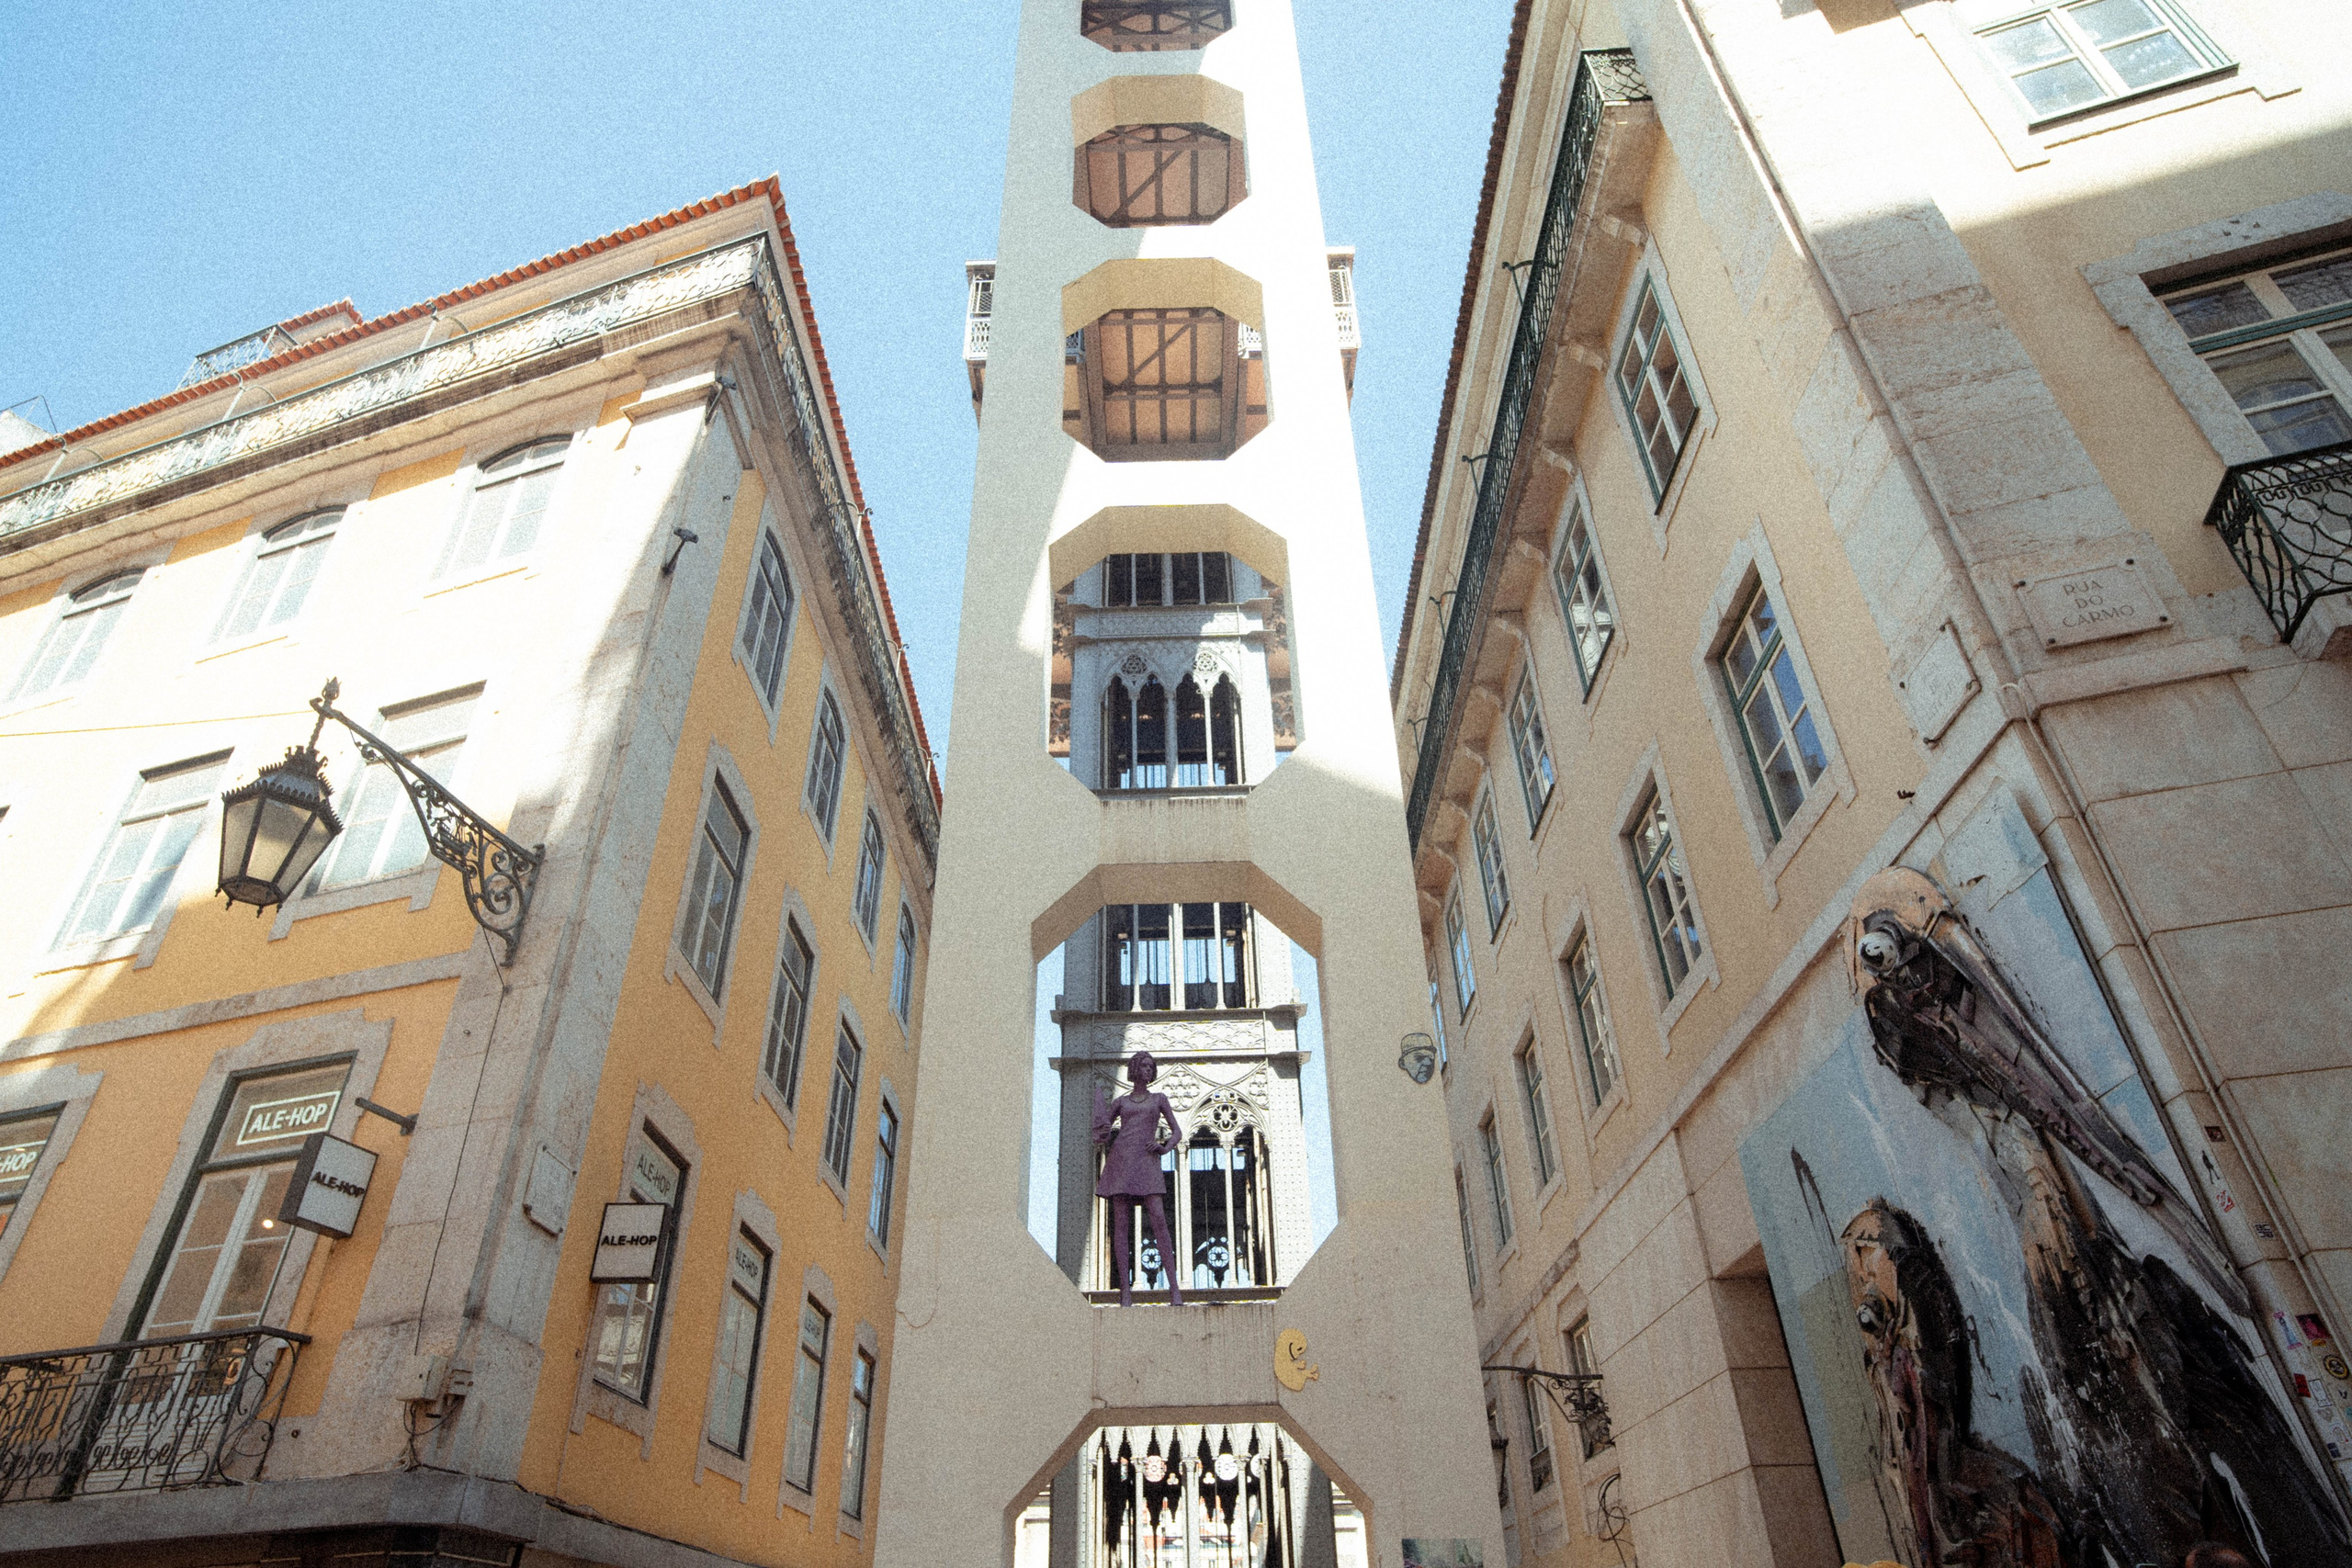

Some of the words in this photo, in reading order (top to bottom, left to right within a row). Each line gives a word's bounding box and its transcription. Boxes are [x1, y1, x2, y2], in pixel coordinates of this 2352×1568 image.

[2063, 580, 2103, 596] RUA
[2075, 595, 2104, 609] DO
[2063, 604, 2135, 627] CARMO
[248, 1103, 328, 1134] ALE-HOP
[311, 1171, 366, 1198] ALE-HOP
[637, 1154, 672, 1197] ALE-HOP
[601, 1235, 658, 1247] ALE-HOP
